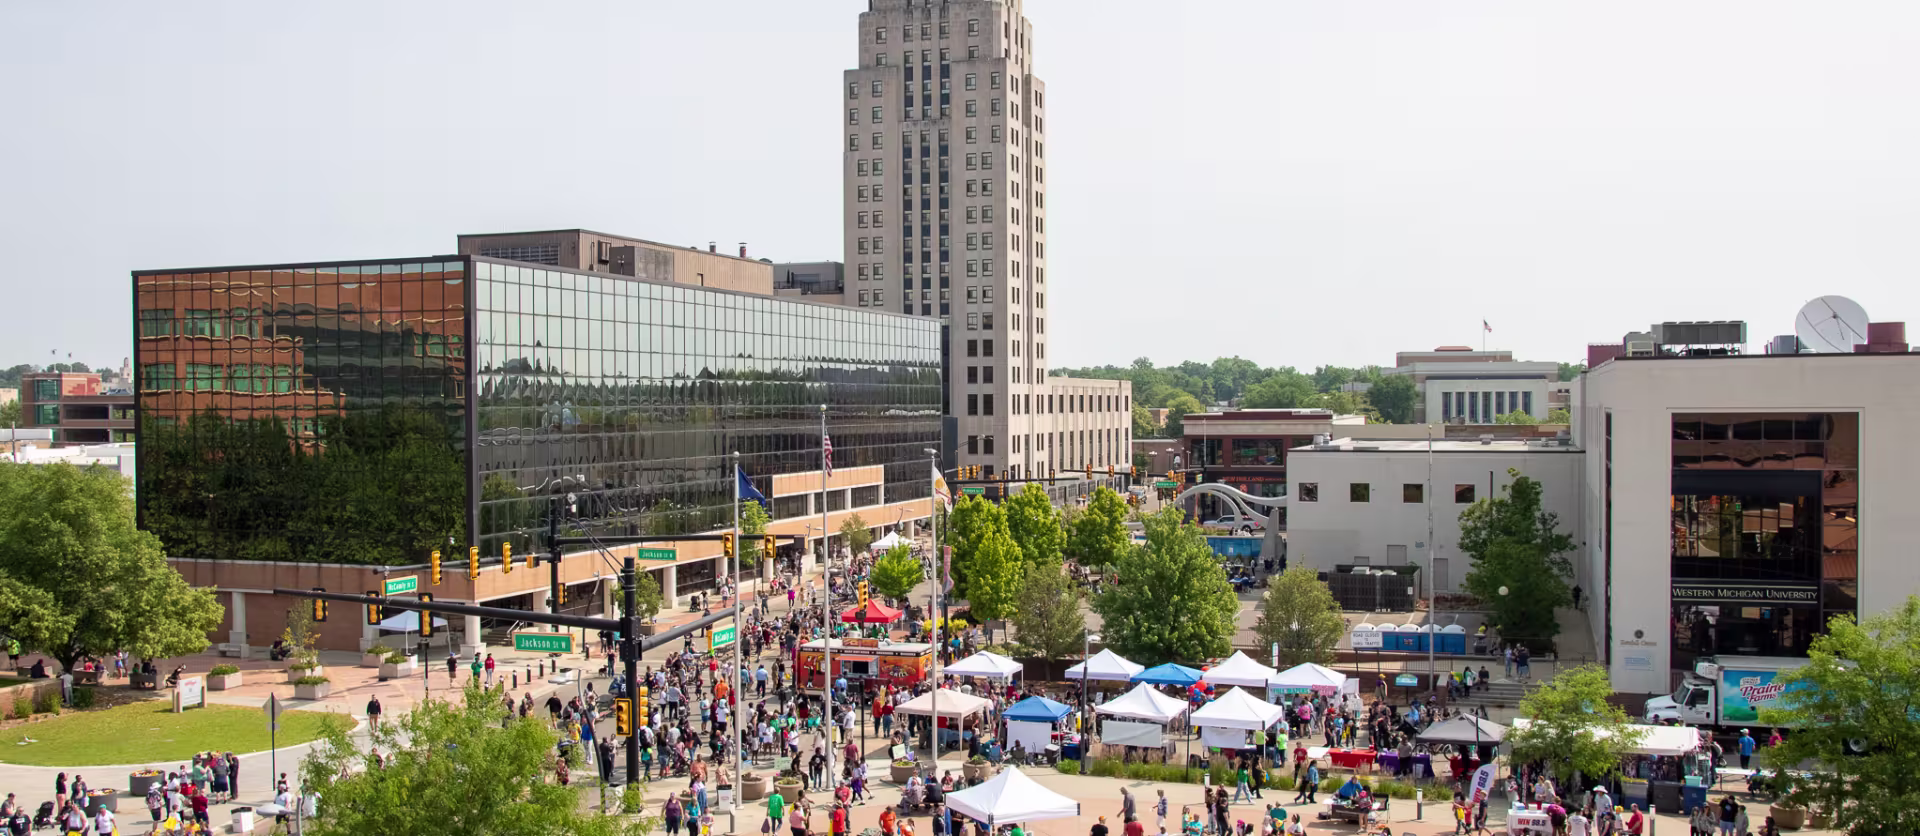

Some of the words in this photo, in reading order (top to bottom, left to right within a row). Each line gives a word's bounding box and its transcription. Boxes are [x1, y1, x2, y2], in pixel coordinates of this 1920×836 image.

[1672, 588, 1715, 597] WESTERN
[1717, 588, 1763, 598] MICHIGAN
[1766, 589, 1818, 599] UNIVERSITY
[521, 638, 550, 649] Jackson
[553, 641, 559, 649] St
[561, 641, 566, 649] W
[1740, 683, 1784, 698] Prairie
[1747, 692, 1777, 703] Farms
[1477, 770, 1489, 788] 98.5
[1517, 818, 1531, 826] WIN
[1531, 819, 1546, 827] 98.5
